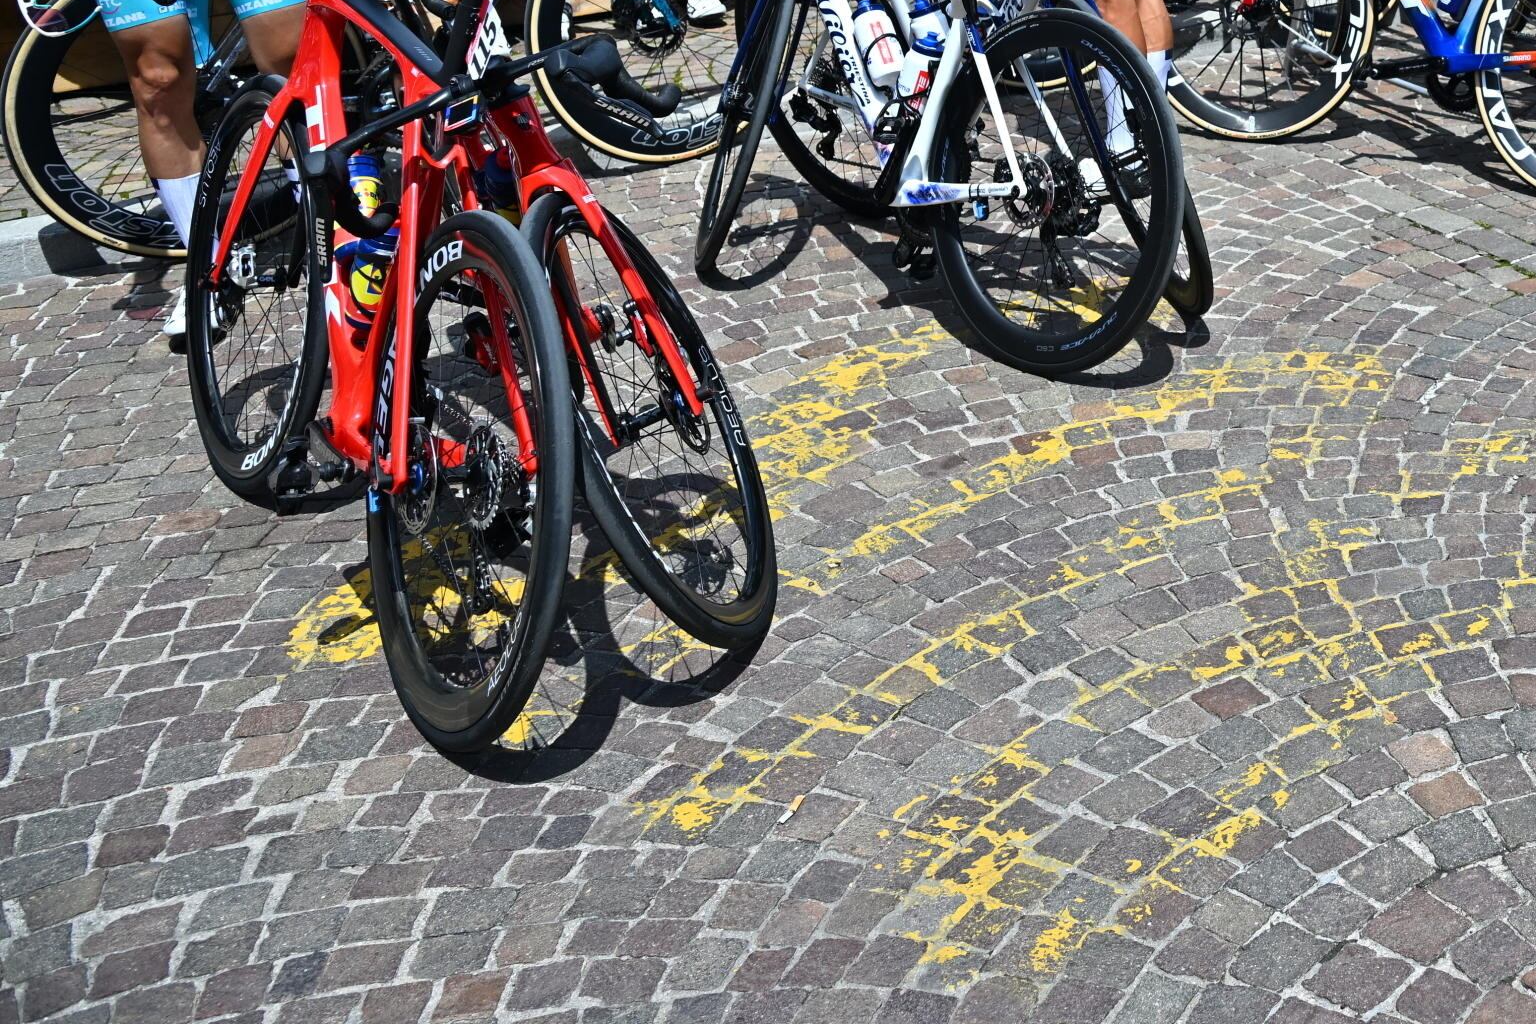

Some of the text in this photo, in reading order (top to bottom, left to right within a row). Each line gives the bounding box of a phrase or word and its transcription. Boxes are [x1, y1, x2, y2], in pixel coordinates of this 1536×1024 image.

[103, 10, 147, 29] IZANE
[469, 19, 498, 77] 115
[1502, 54, 1532, 63] SHIMANO
[849, 56, 872, 105] TRIESTINA
[594, 97, 651, 130] SRAM
[199, 136, 222, 209] AEOLUS
[315, 216, 328, 267] SRAM
[698, 344, 748, 447] AEOLUS
